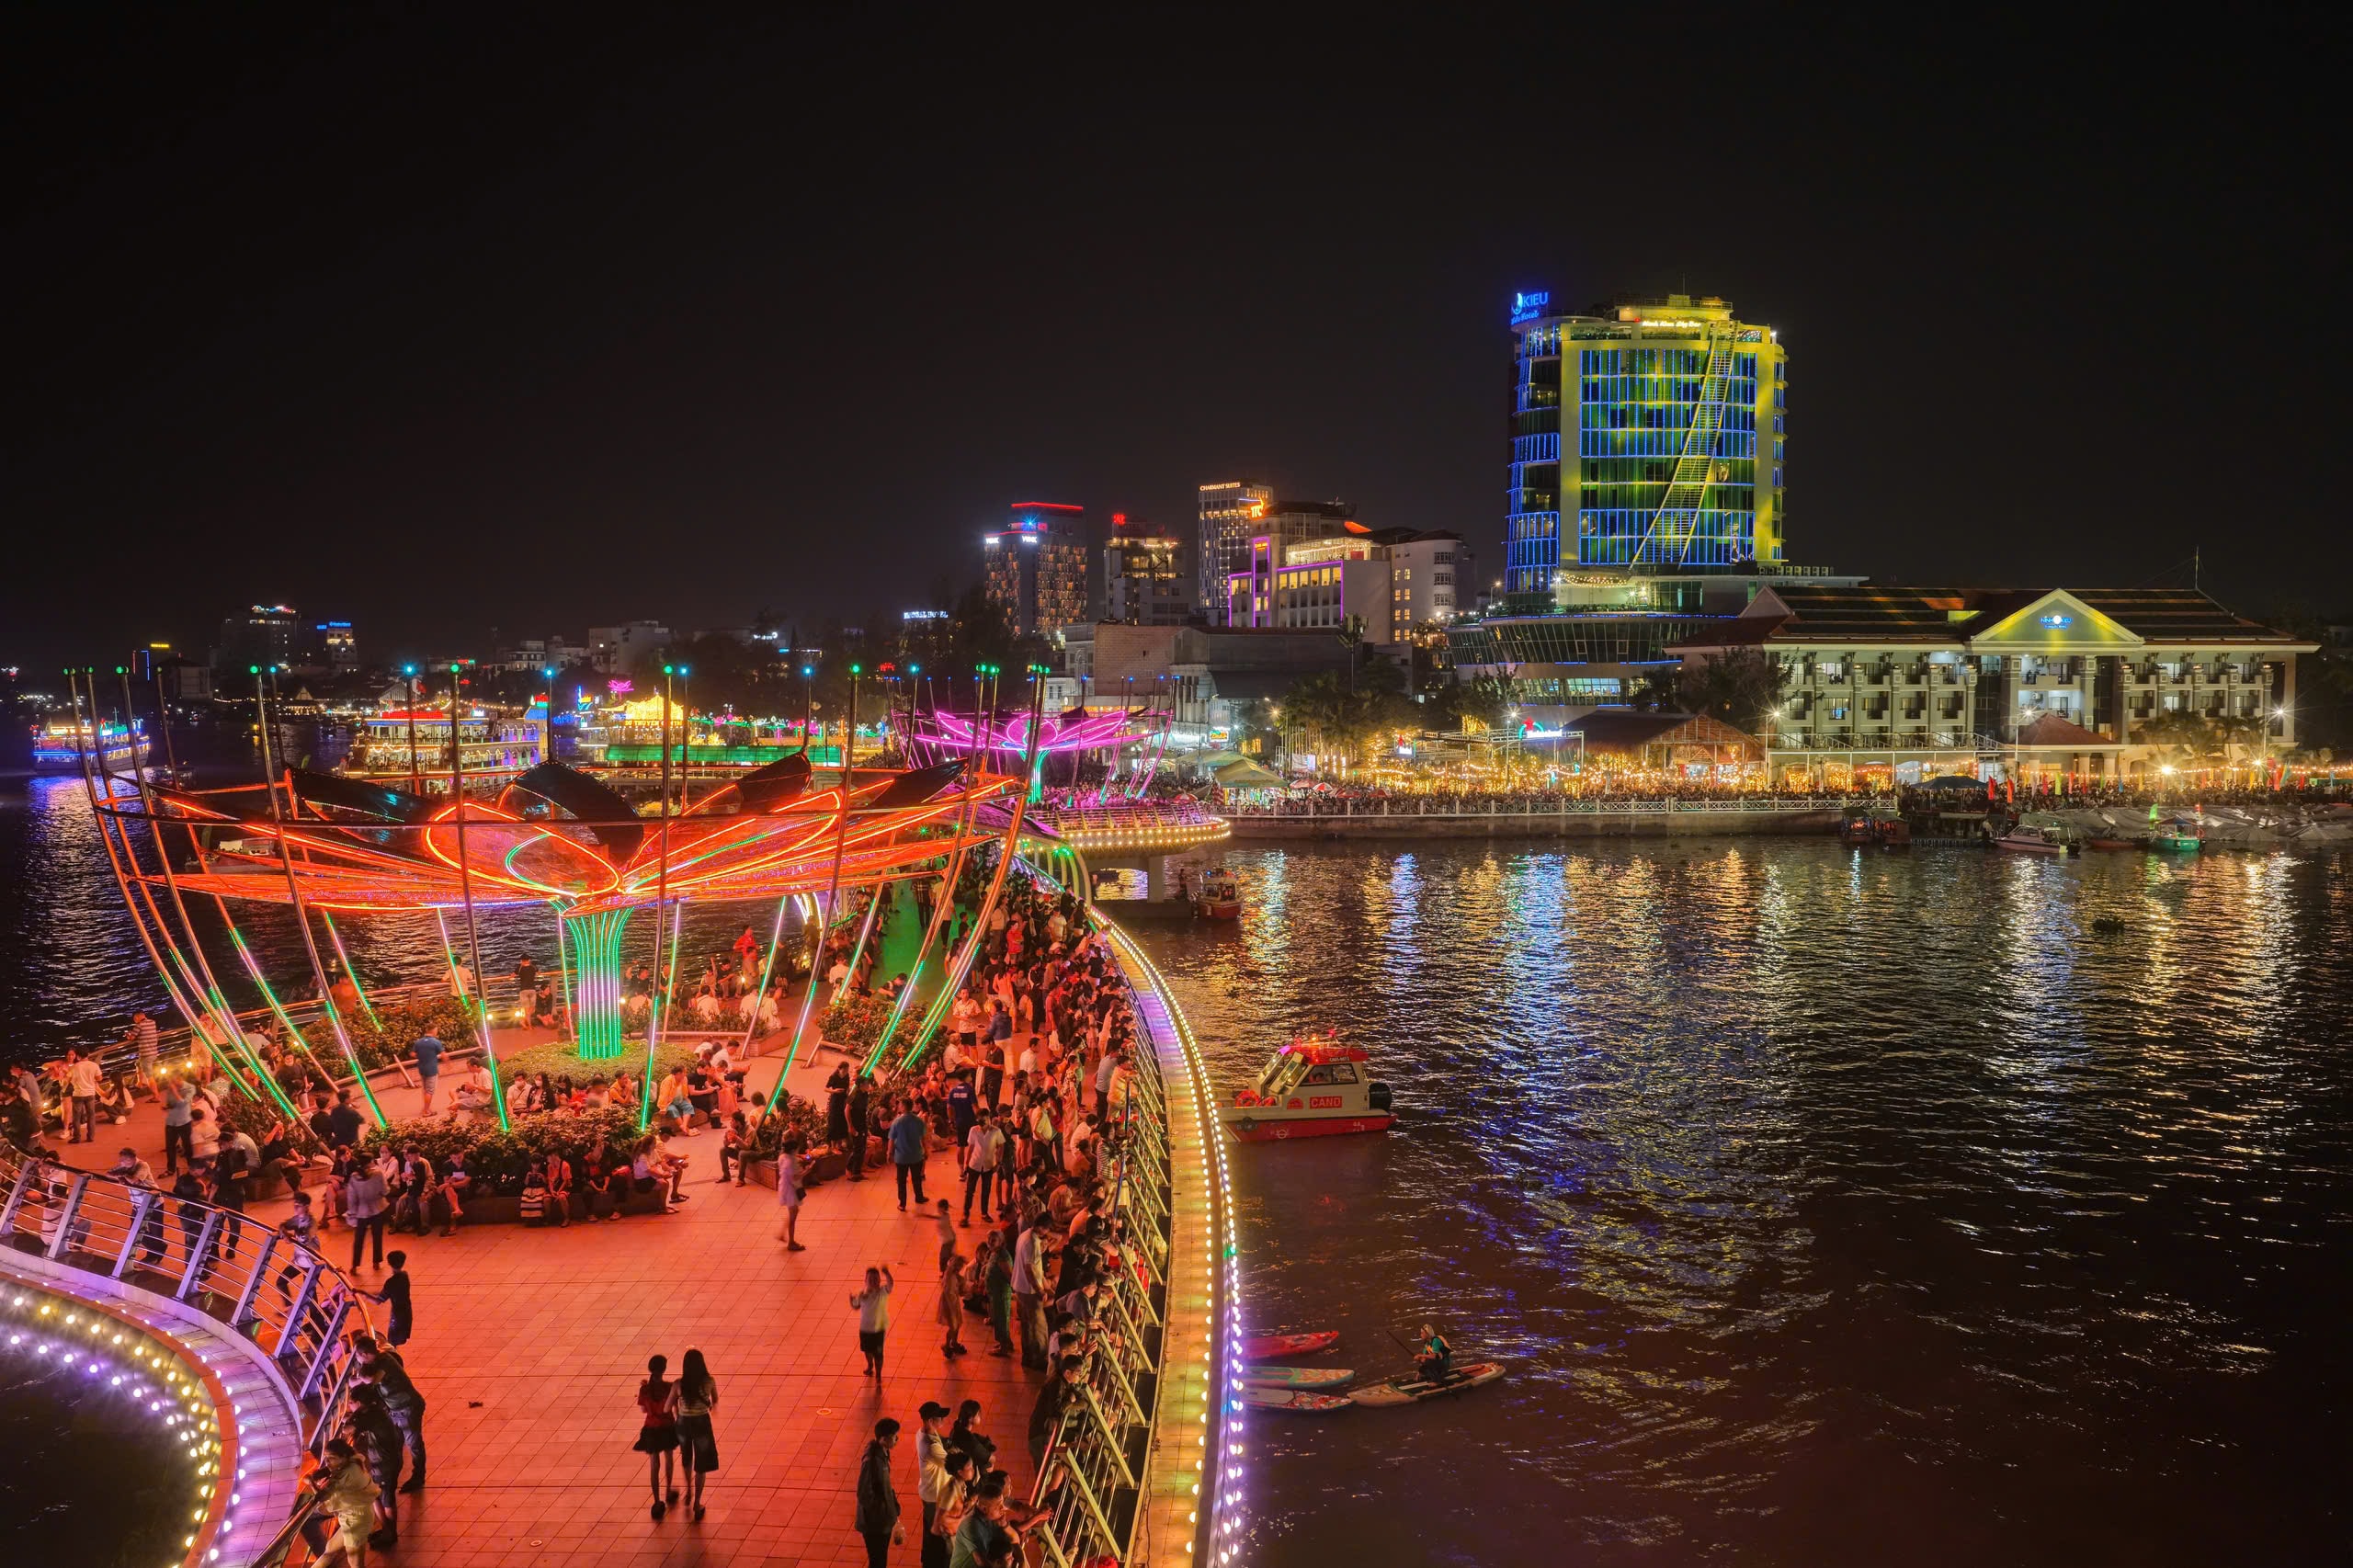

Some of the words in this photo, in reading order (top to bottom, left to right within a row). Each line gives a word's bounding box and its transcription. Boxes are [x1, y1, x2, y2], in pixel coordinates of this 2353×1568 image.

[1199, 483, 1225, 492] CHARMANT
[1225, 482, 1241, 490] SUITES
[1311, 1097, 1341, 1108] CAND
